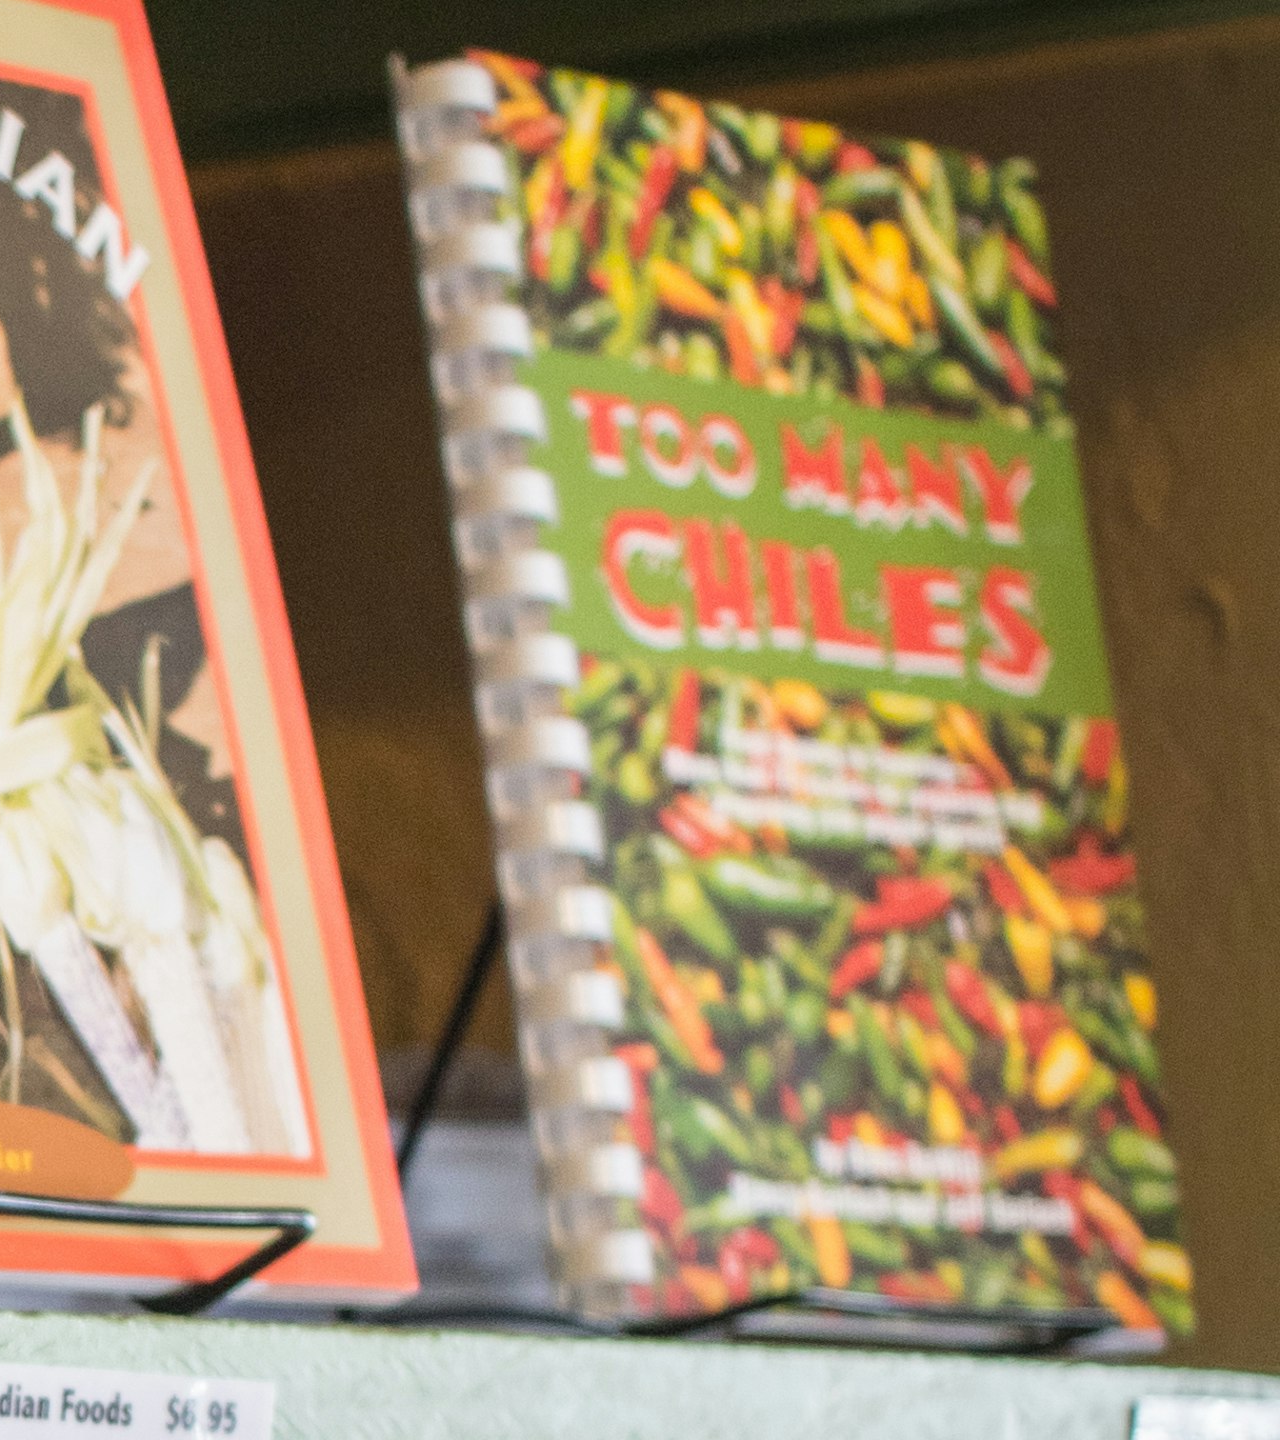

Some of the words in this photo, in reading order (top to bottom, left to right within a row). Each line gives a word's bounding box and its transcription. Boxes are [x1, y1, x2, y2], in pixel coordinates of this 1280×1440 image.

[570, 389, 756, 498] TOO
[780, 421, 1033, 544] MANY
[601, 509, 1051, 696] CHILES
[60, 1388, 133, 1427] Foods
[165, 1395, 237, 1434] $695
